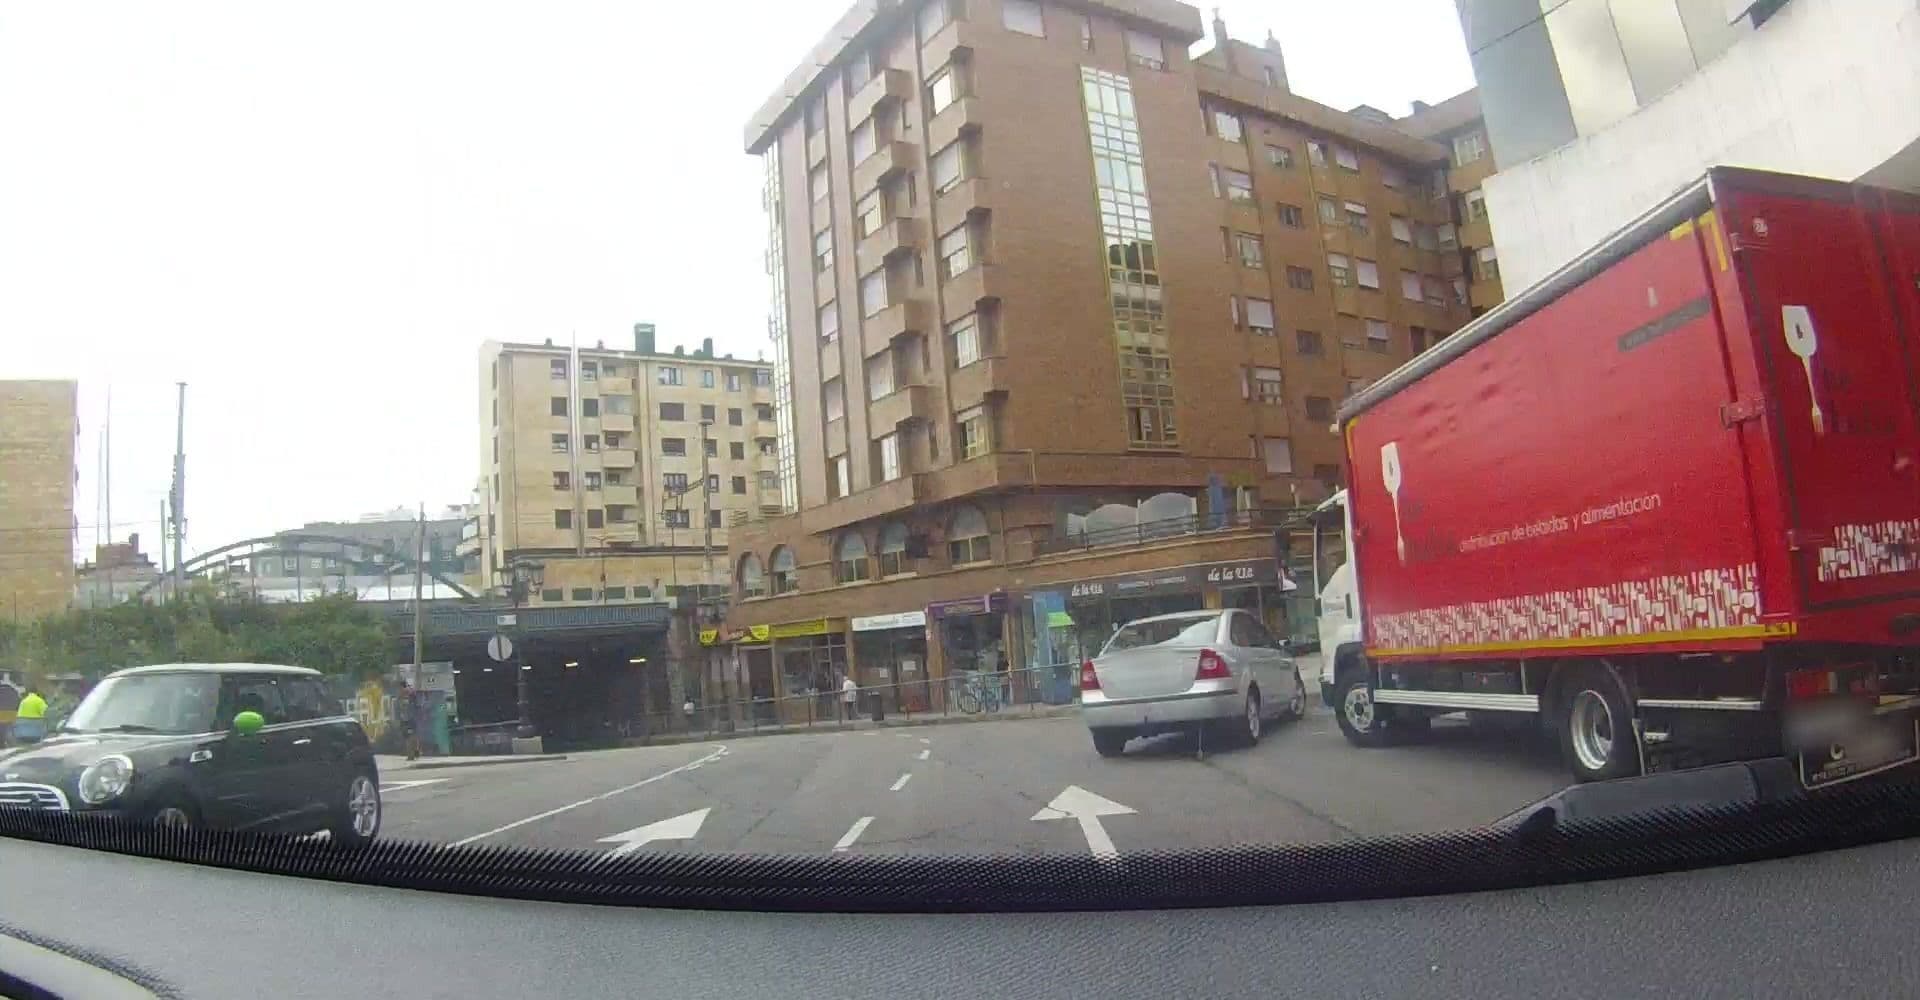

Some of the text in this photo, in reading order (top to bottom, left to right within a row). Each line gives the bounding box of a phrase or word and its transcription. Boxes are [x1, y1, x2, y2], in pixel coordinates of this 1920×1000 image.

[1511, 523, 1525, 541] de
[1525, 514, 1568, 538] bebidas
[1572, 513, 1580, 532] y
